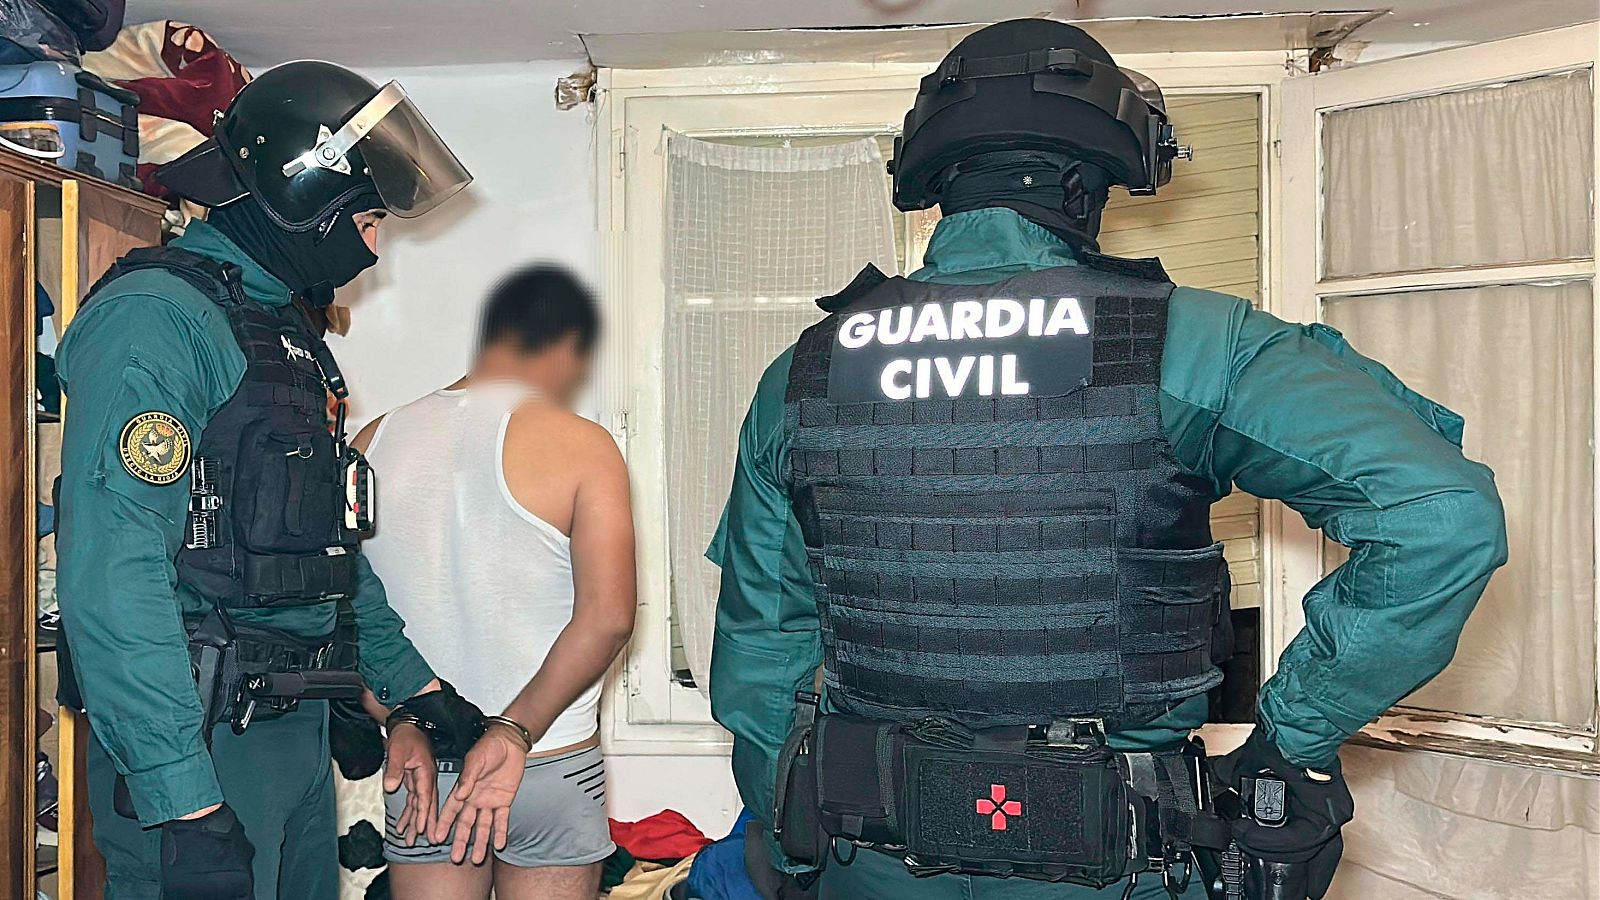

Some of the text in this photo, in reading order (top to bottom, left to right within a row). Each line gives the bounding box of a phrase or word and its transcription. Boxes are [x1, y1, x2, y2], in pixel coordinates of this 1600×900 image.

[838, 297, 1090, 349] GUARDIA
[879, 354, 1030, 400] CIVIL
[136, 414, 173, 424] GUARDIA
